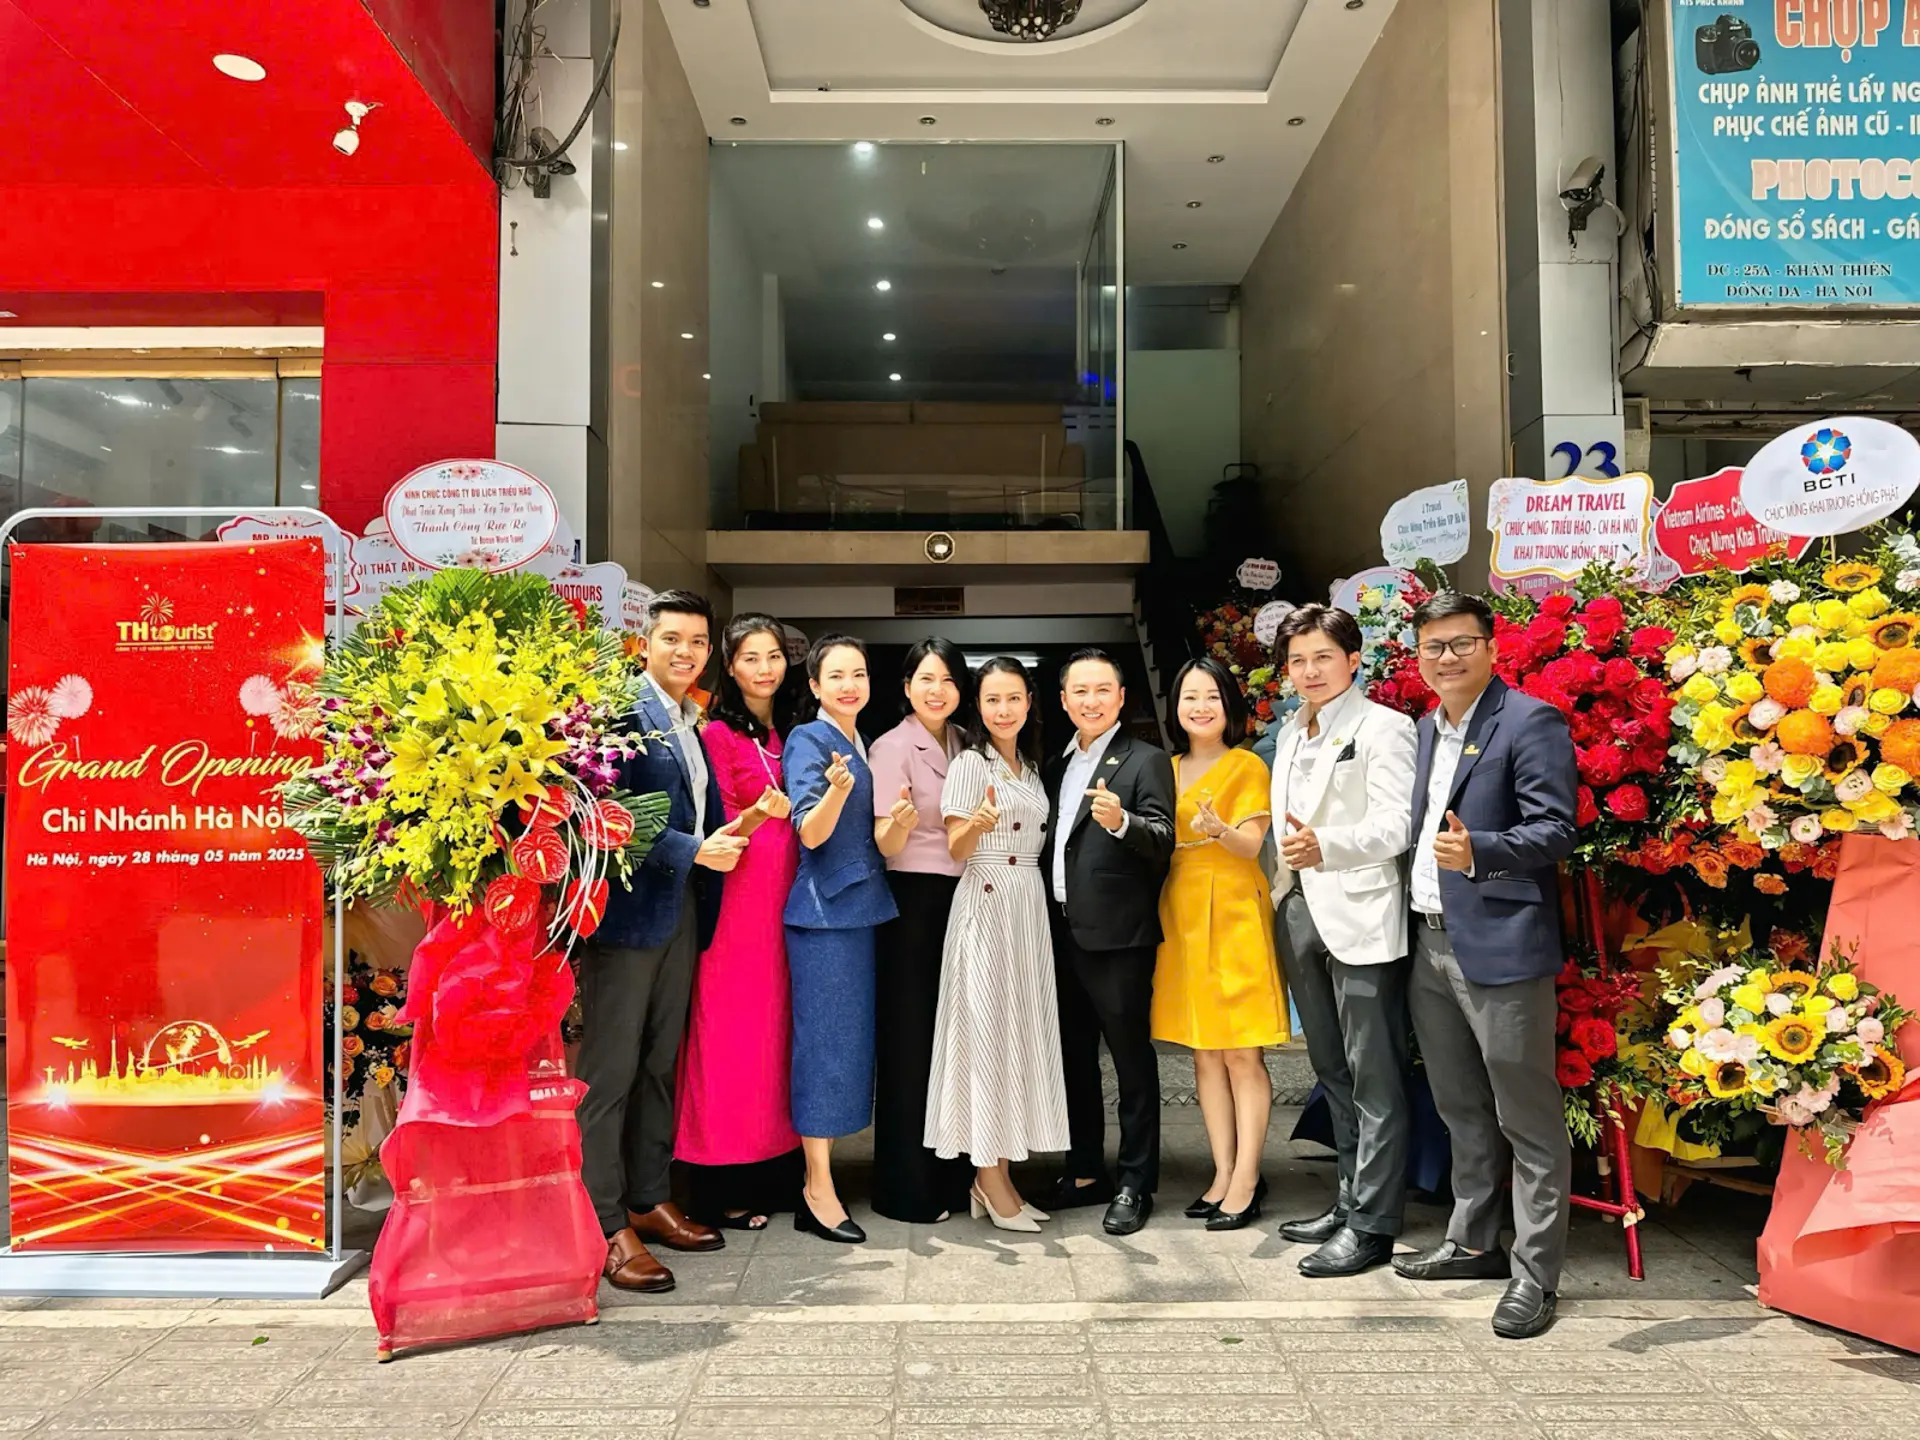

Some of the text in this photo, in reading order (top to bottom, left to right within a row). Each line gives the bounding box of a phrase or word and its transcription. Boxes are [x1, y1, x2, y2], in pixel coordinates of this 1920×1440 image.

[1775, 0, 1890, 63] CHỤP
[1699, 83, 1749, 110] CHỤP
[1757, 75, 1799, 103] ẢNH
[1804, 74, 1841, 103] THẺ
[1849, 73, 1885, 103] LẤY
[1713, 116, 1765, 142] PHỤC
[1771, 107, 1810, 136] CHẾ
[1816, 108, 1858, 136] ẢNH
[1865, 113, 1890, 136] CŨ
[1705, 213, 1770, 239] ĐÓNG
[1778, 208, 1806, 239] SỔ
[1812, 213, 1865, 239] SÁCH
[1744, 264, 1771, 276] 25A
[1550, 441, 1621, 478] 23
[462, 488, 469, 498] TY
[1804, 473, 1856, 492] BCTI
[1526, 492, 1626, 512] DREAM TRAVEL
[1598, 519, 1609, 535] CN
[1662, 508, 1694, 529] Vietnam
[1695, 501, 1725, 524] Airlines
[1736, 525, 1755, 548] Khai
[1513, 546, 1533, 560] KHAI
[18, 742, 157, 795] Grand
[42, 806, 87, 833] Chi
[94, 804, 187, 832] Nhánh
[195, 806, 233, 830] Hà
[27, 852, 48, 866] Hà
[89, 852, 126, 868] ngày
[132, 852, 151, 864] 28
[155, 851, 199, 866] tháng
[204, 850, 223, 863] 05
[229, 850, 261, 862] năm
[267, 848, 304, 861] 2025
